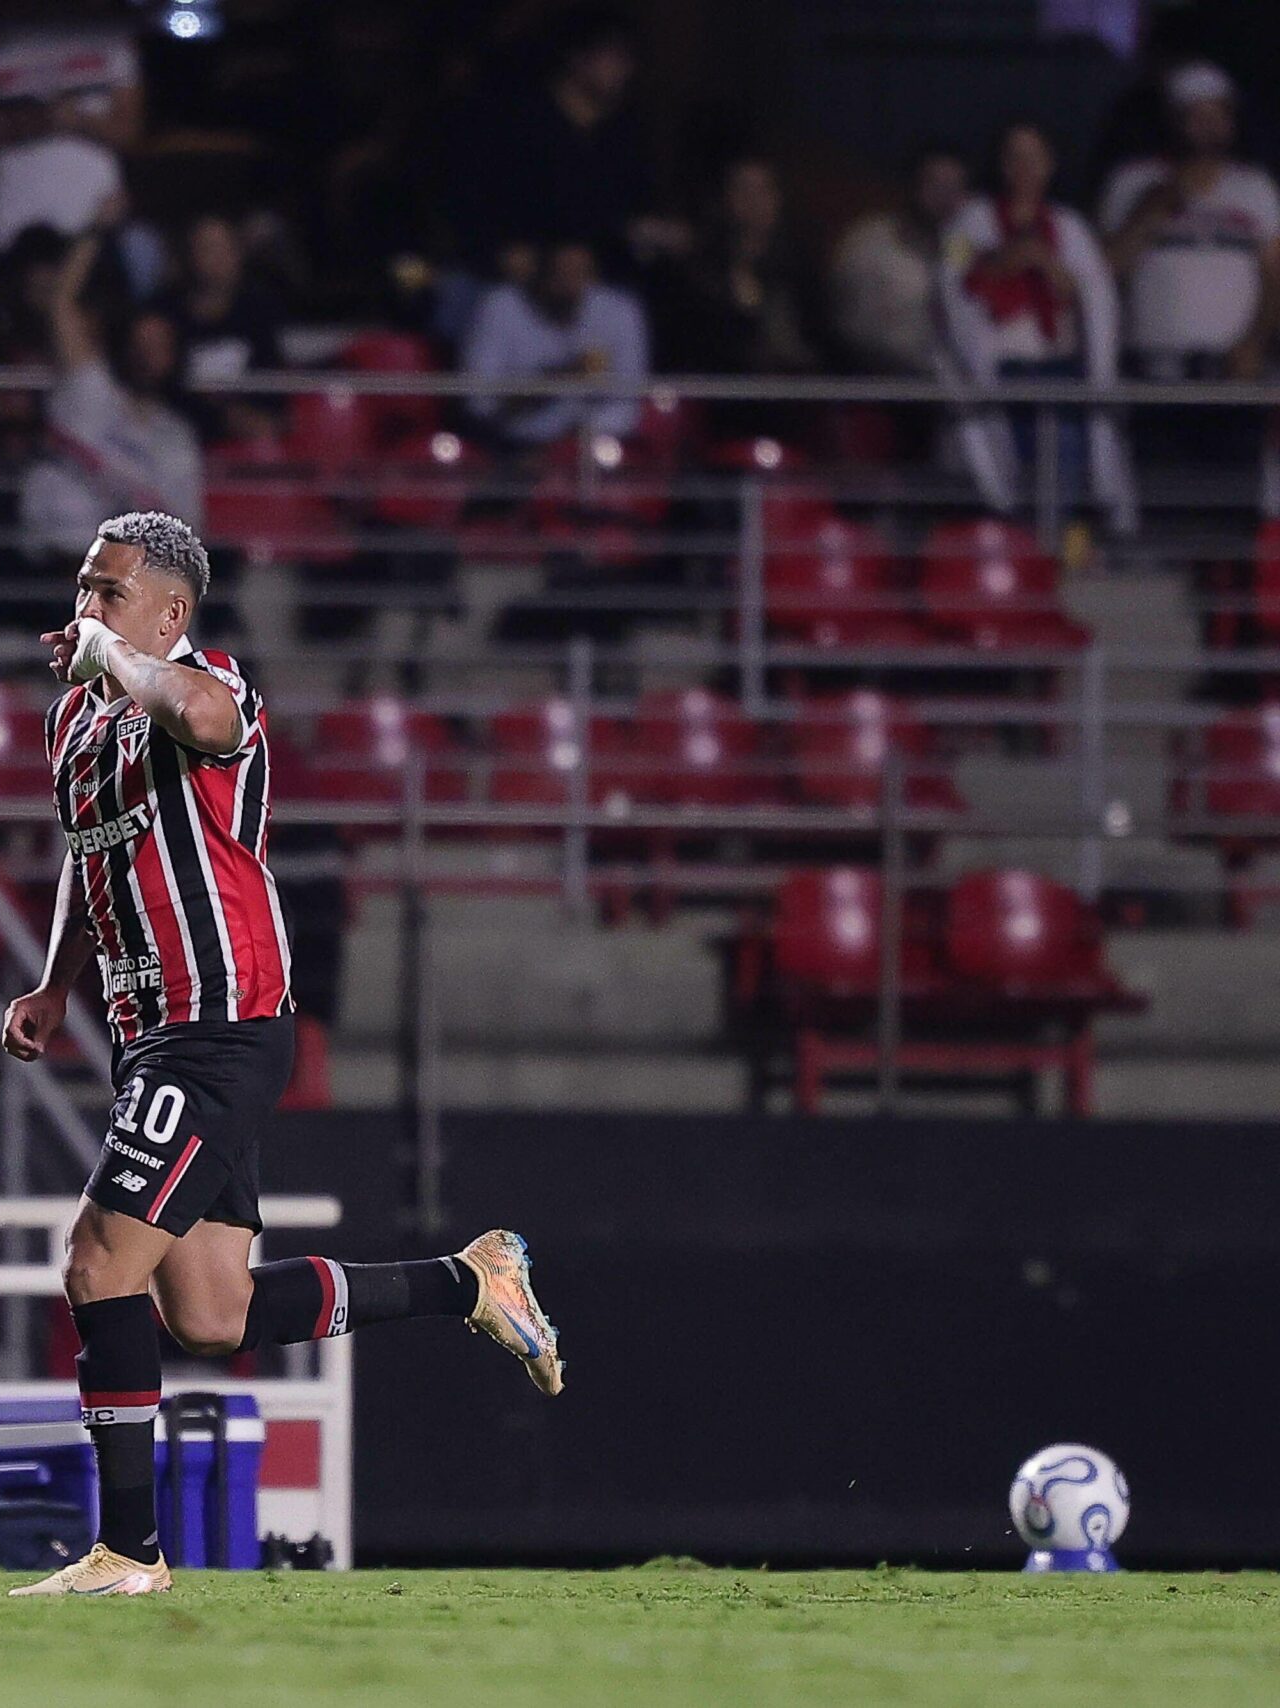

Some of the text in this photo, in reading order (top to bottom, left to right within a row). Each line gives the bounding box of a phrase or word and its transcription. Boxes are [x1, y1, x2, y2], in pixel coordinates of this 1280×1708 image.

[120, 718, 147, 736] SPFC
[72, 778, 100, 798] elgin
[137, 953, 161, 969] DA
[112, 967, 161, 993] GENTE
[115, 1076, 186, 1144] 10
